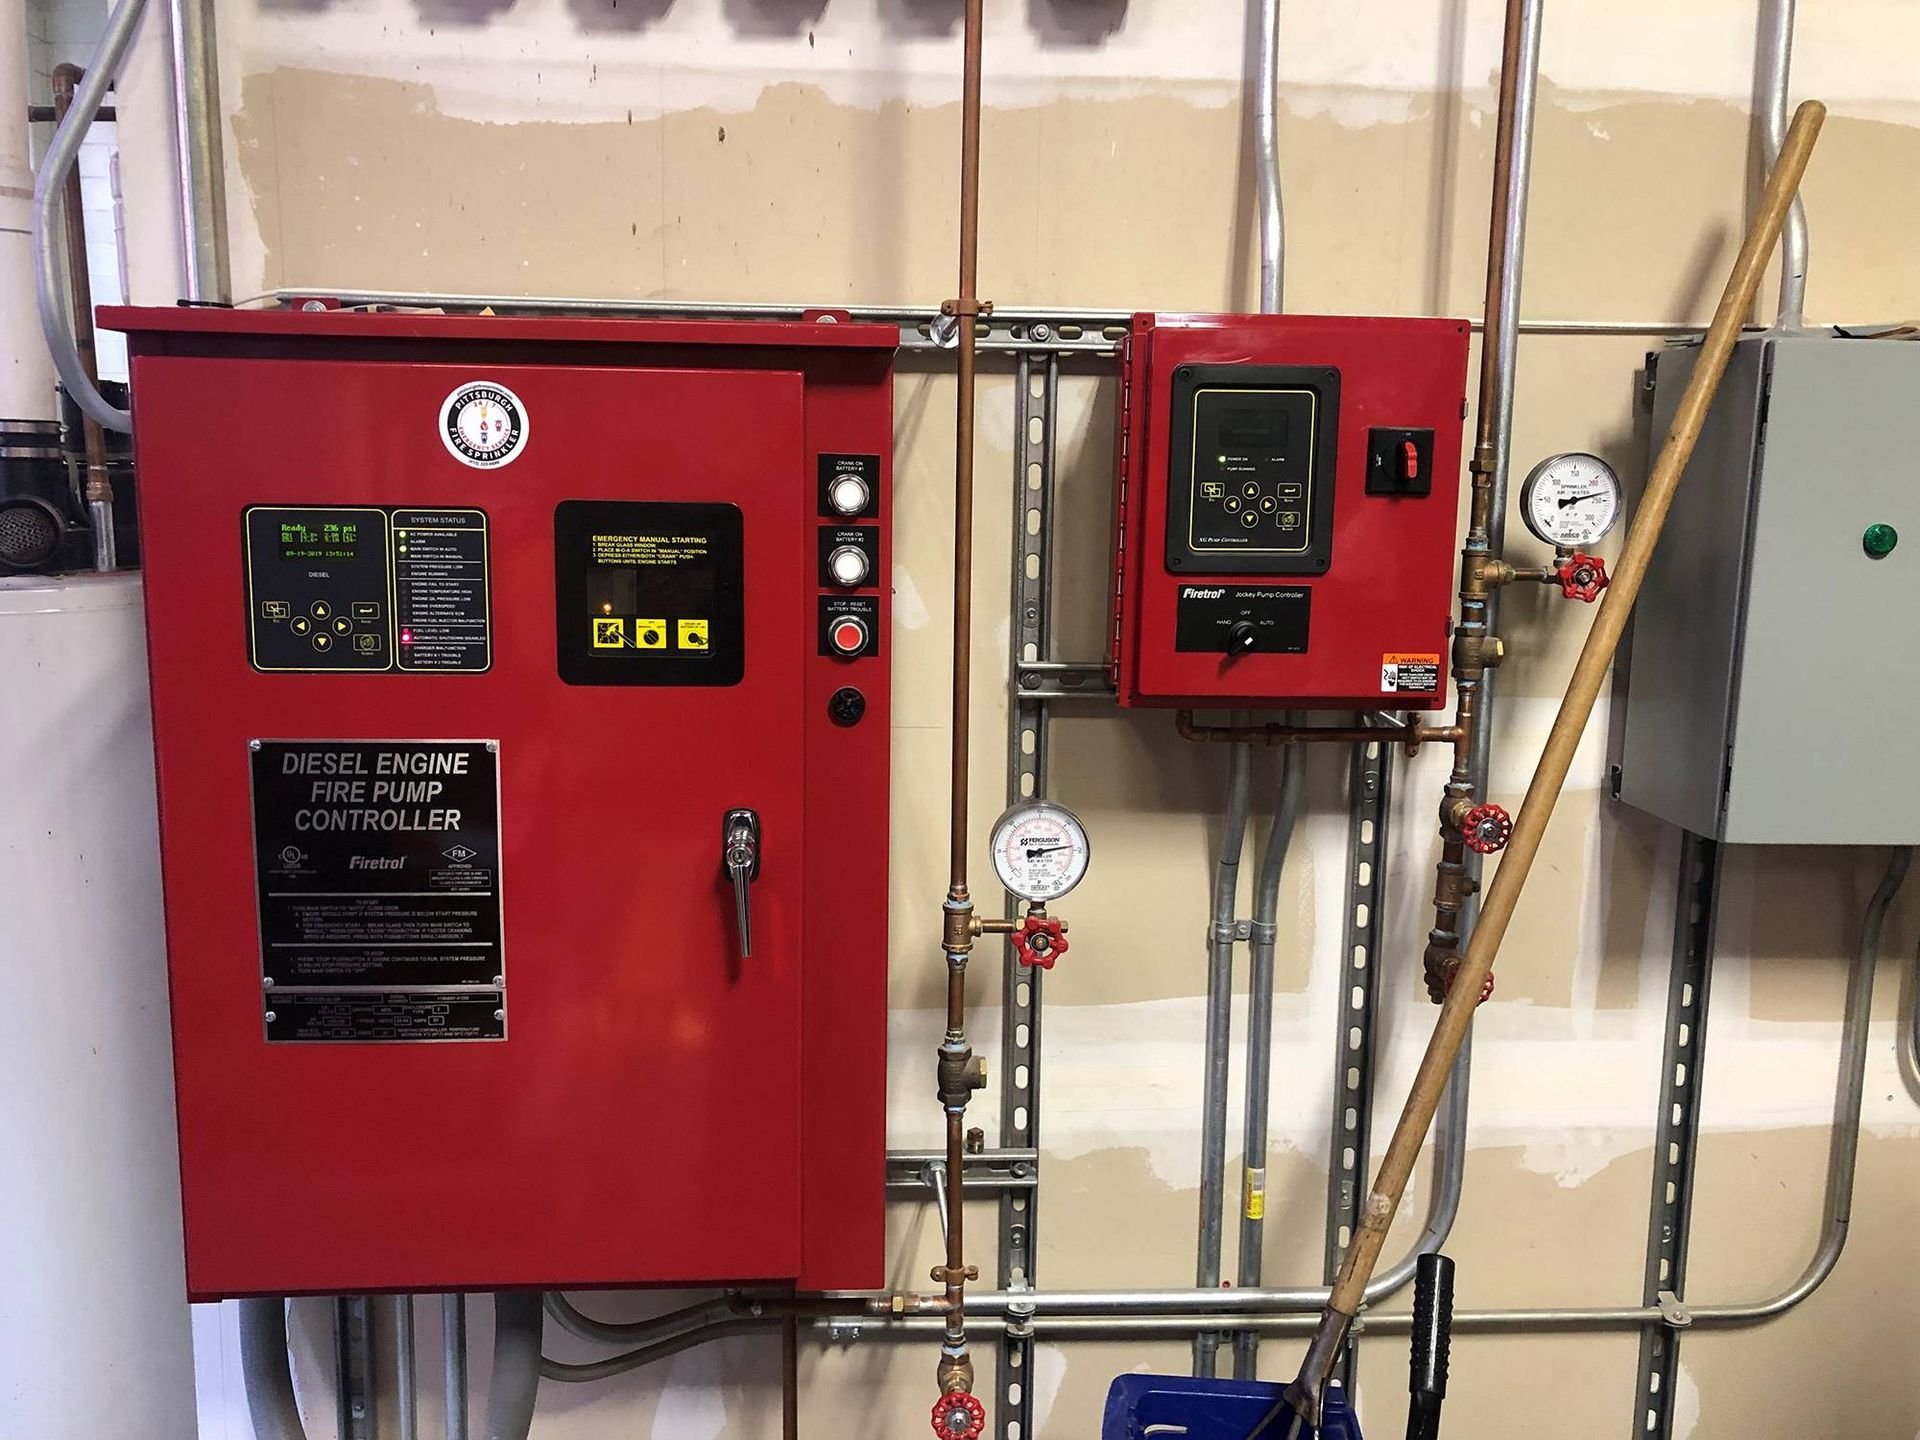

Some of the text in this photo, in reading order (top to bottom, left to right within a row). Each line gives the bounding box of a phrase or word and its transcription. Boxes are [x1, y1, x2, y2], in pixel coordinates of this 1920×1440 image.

[455, 391, 513, 412] PITTSBURGH
[450, 428, 519, 460] FIRE SPRINKLER
[459, 426, 509, 450] EMERGENCY SERVICE
[343, 524, 356, 533] psi
[282, 752, 470, 775] DIESEL ENGINE
[311, 781, 443, 802] FIRE PUMP
[295, 809, 461, 831] CONTROLLER
